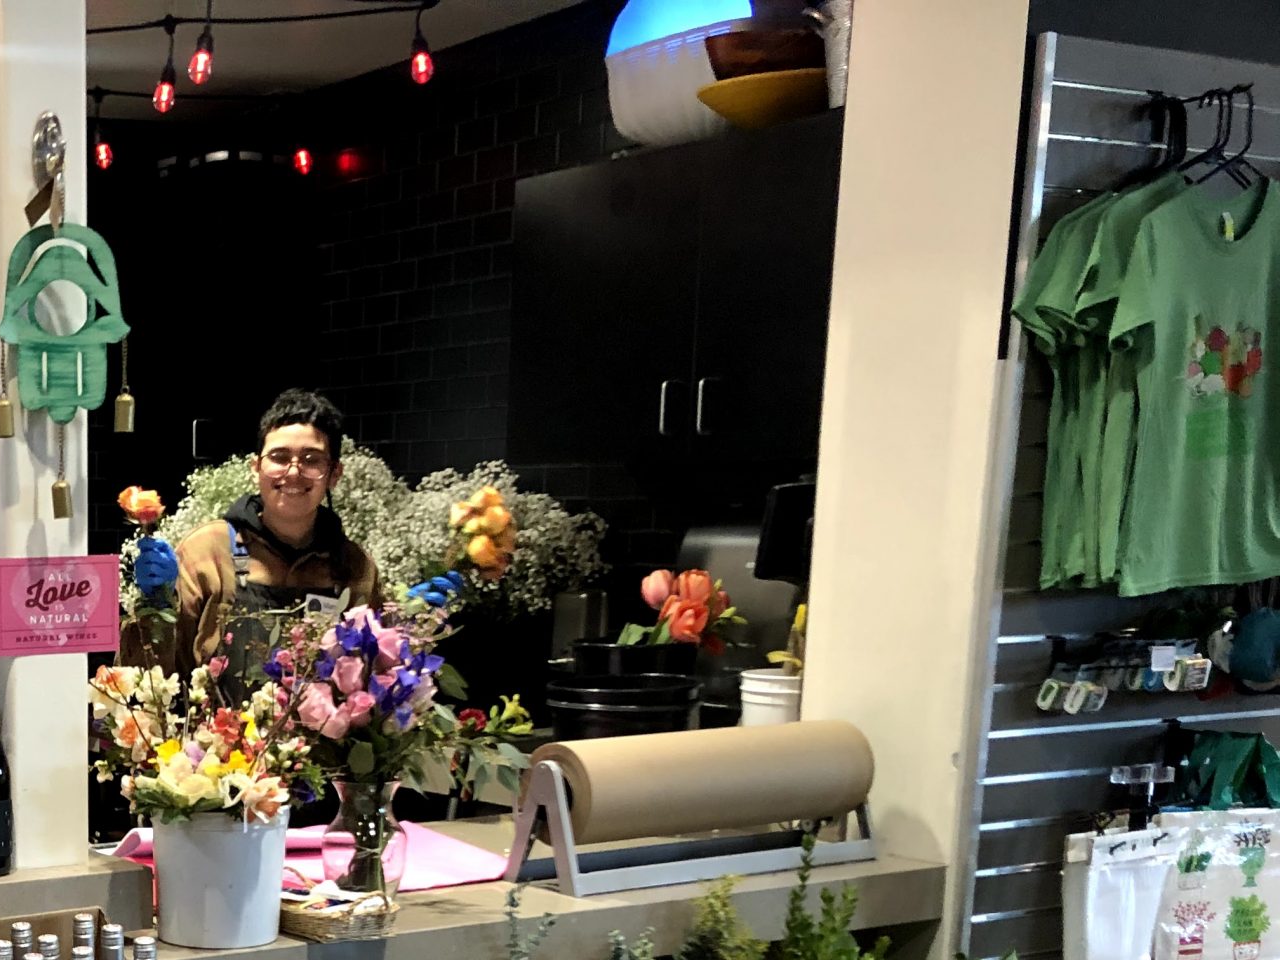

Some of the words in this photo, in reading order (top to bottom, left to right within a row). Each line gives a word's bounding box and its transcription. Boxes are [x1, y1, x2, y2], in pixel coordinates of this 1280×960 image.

[48, 572, 72, 582] ALL
[25, 579, 93, 612] Love
[29, 613, 88, 625] NATURAL
[15, 634, 61, 643] NATURAL
[66, 632, 97, 641] WINES
